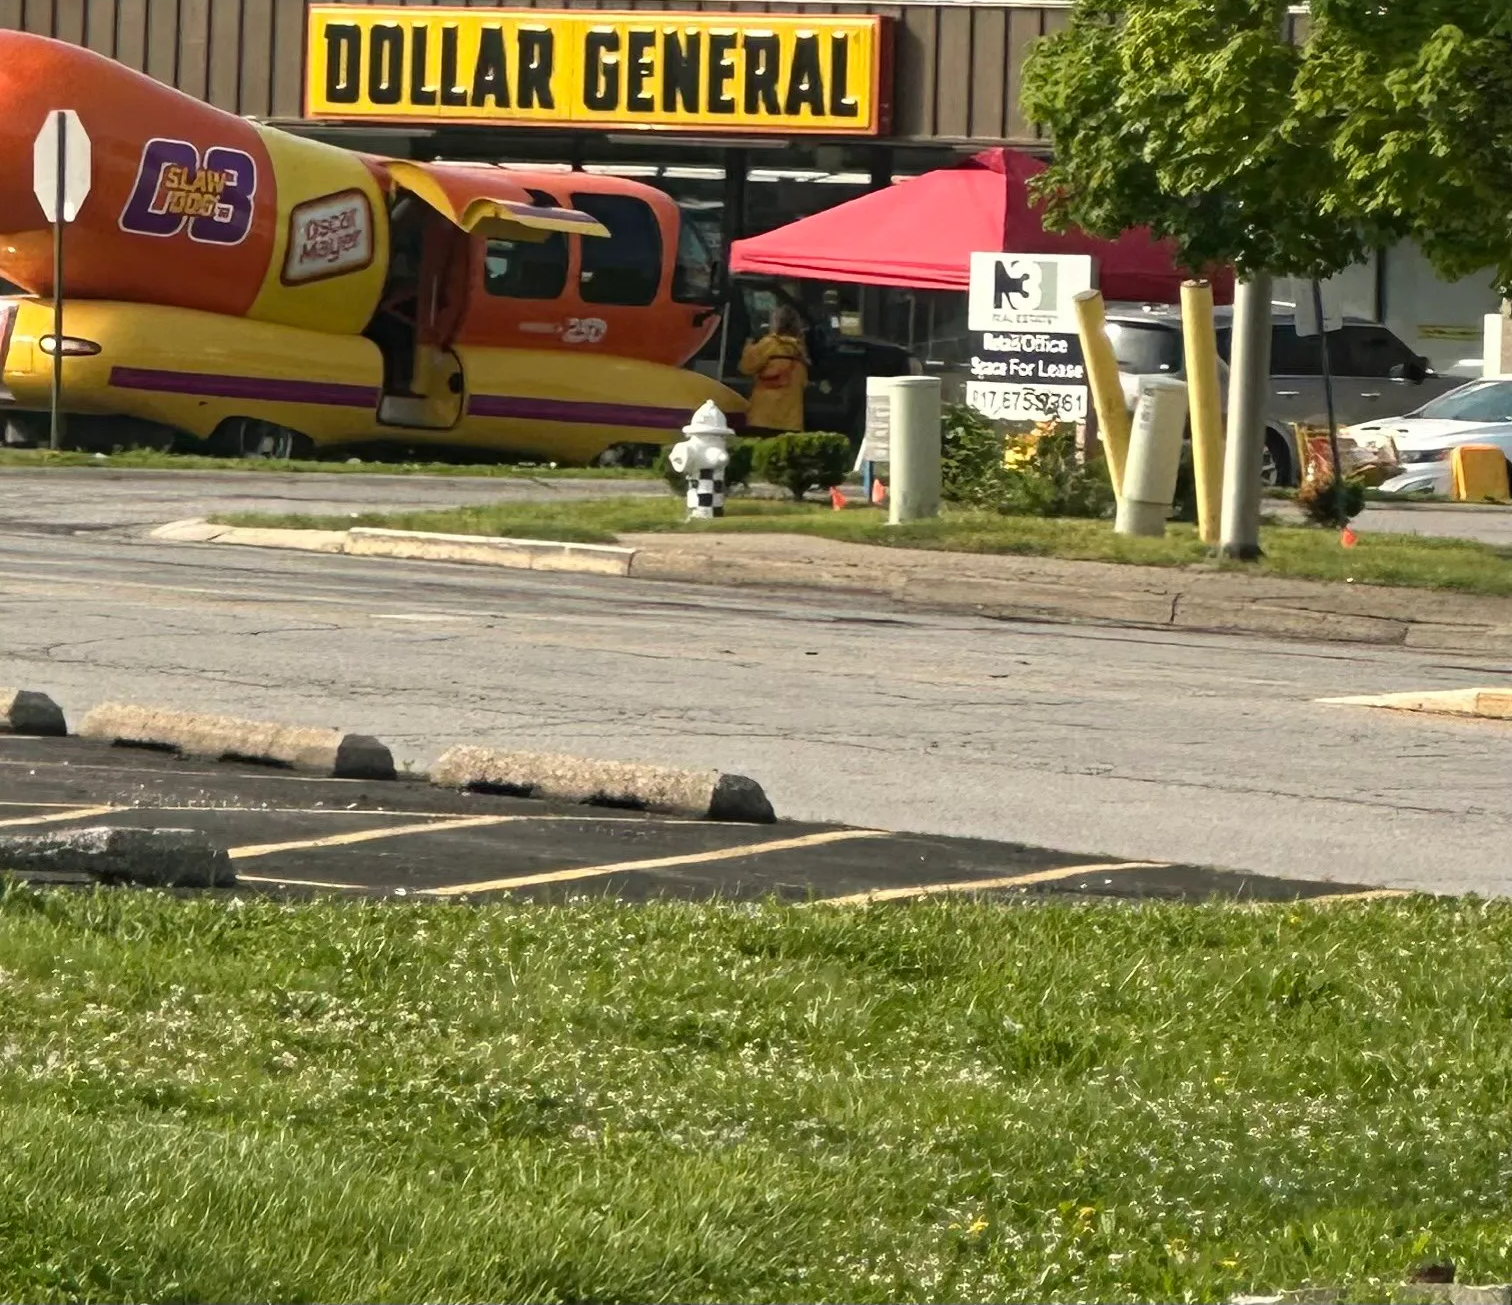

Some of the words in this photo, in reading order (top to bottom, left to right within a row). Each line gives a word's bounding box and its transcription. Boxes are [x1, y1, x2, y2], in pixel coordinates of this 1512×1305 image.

[324, 20, 555, 111] DOLLAR
[582, 23, 858, 118] GENERAL
[165, 165, 226, 194] SLAW
[1009, 358, 1036, 377] For
[1038, 359, 1085, 379] Lease
